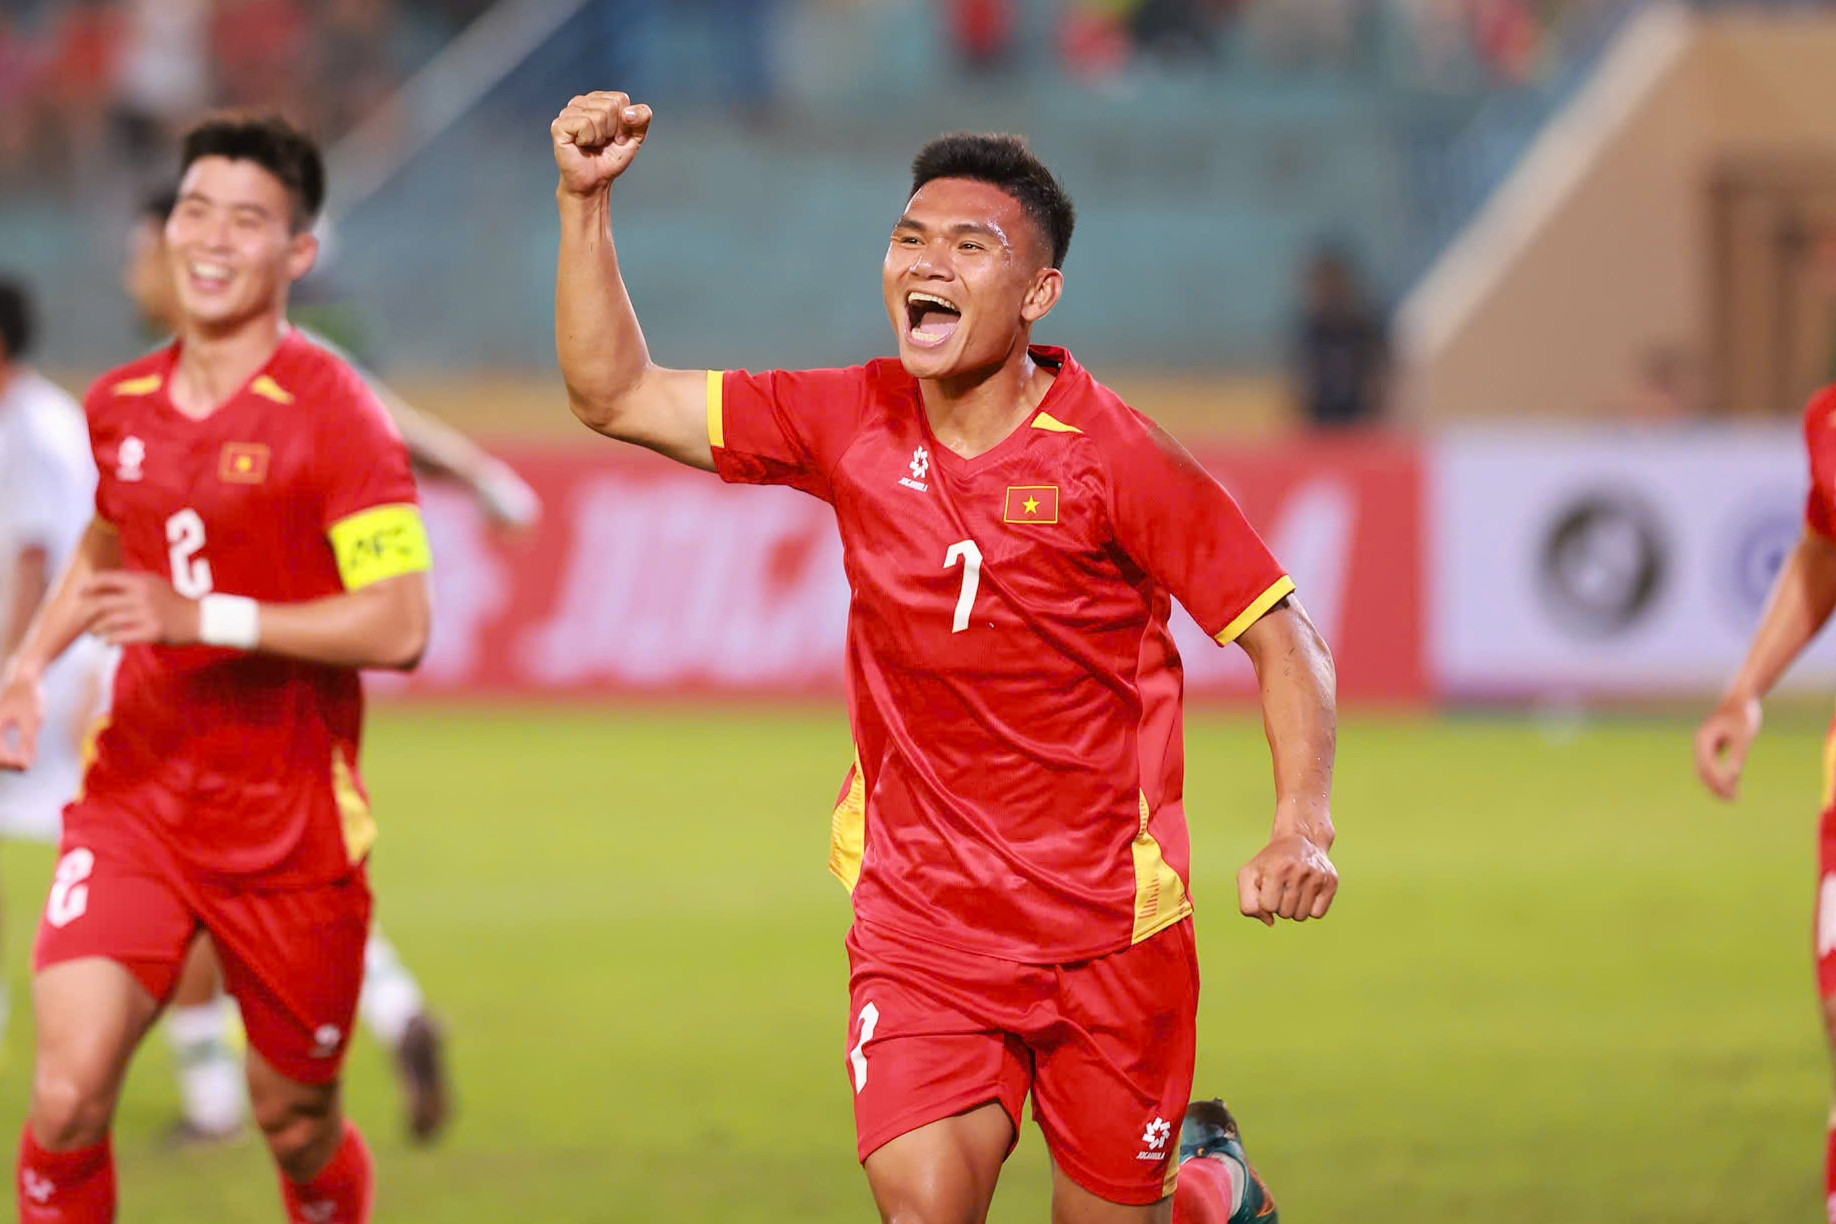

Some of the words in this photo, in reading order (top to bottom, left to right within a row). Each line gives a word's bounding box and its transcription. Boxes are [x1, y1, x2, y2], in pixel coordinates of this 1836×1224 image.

[165, 508, 214, 598] 2
[943, 540, 983, 633] 7
[47, 847, 95, 928] 2
[850, 1001, 880, 1095] 7
